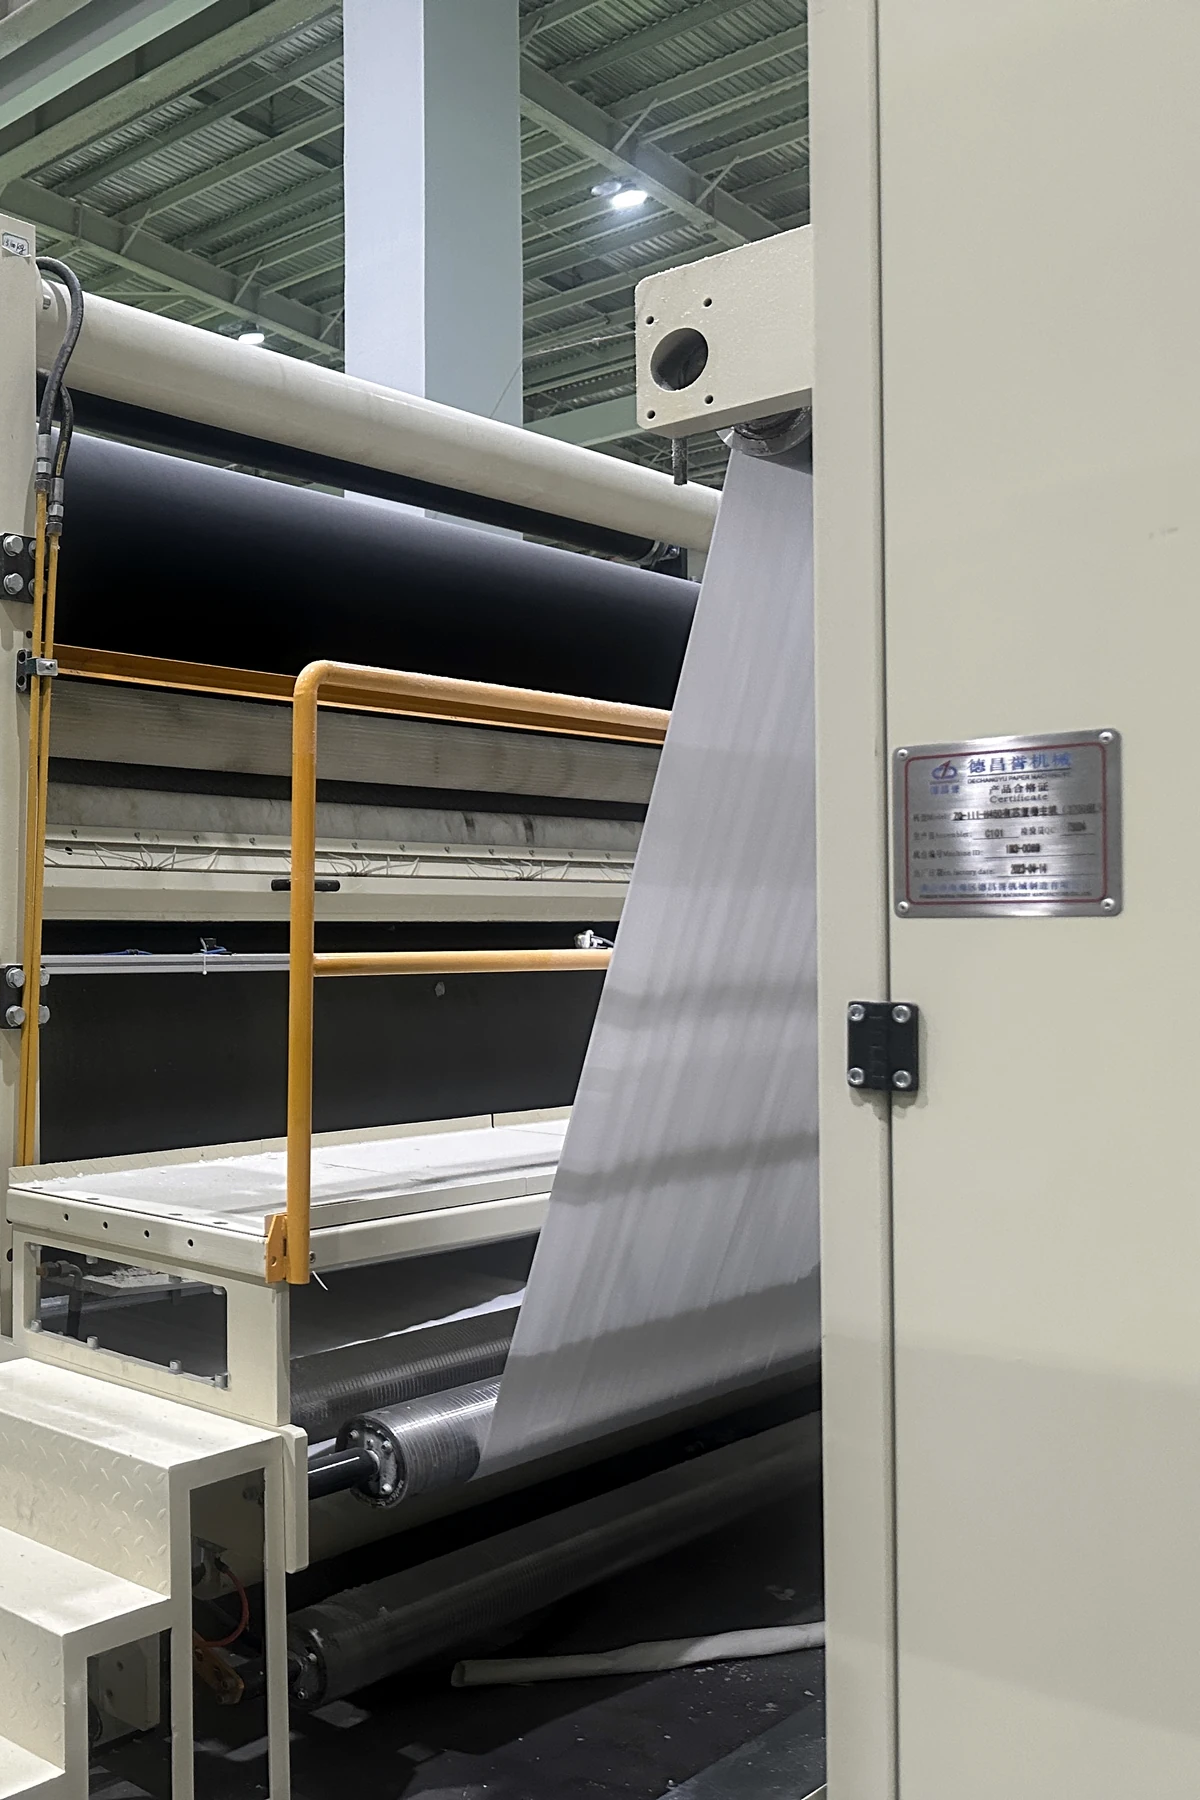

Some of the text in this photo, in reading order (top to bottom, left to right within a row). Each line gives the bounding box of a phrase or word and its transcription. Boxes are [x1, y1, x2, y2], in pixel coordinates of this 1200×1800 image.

[967, 753, 1071, 774] 德昌誉机械
[989, 781, 1049, 795] 产品合格证
[989, 794, 1049, 804] Certificate
